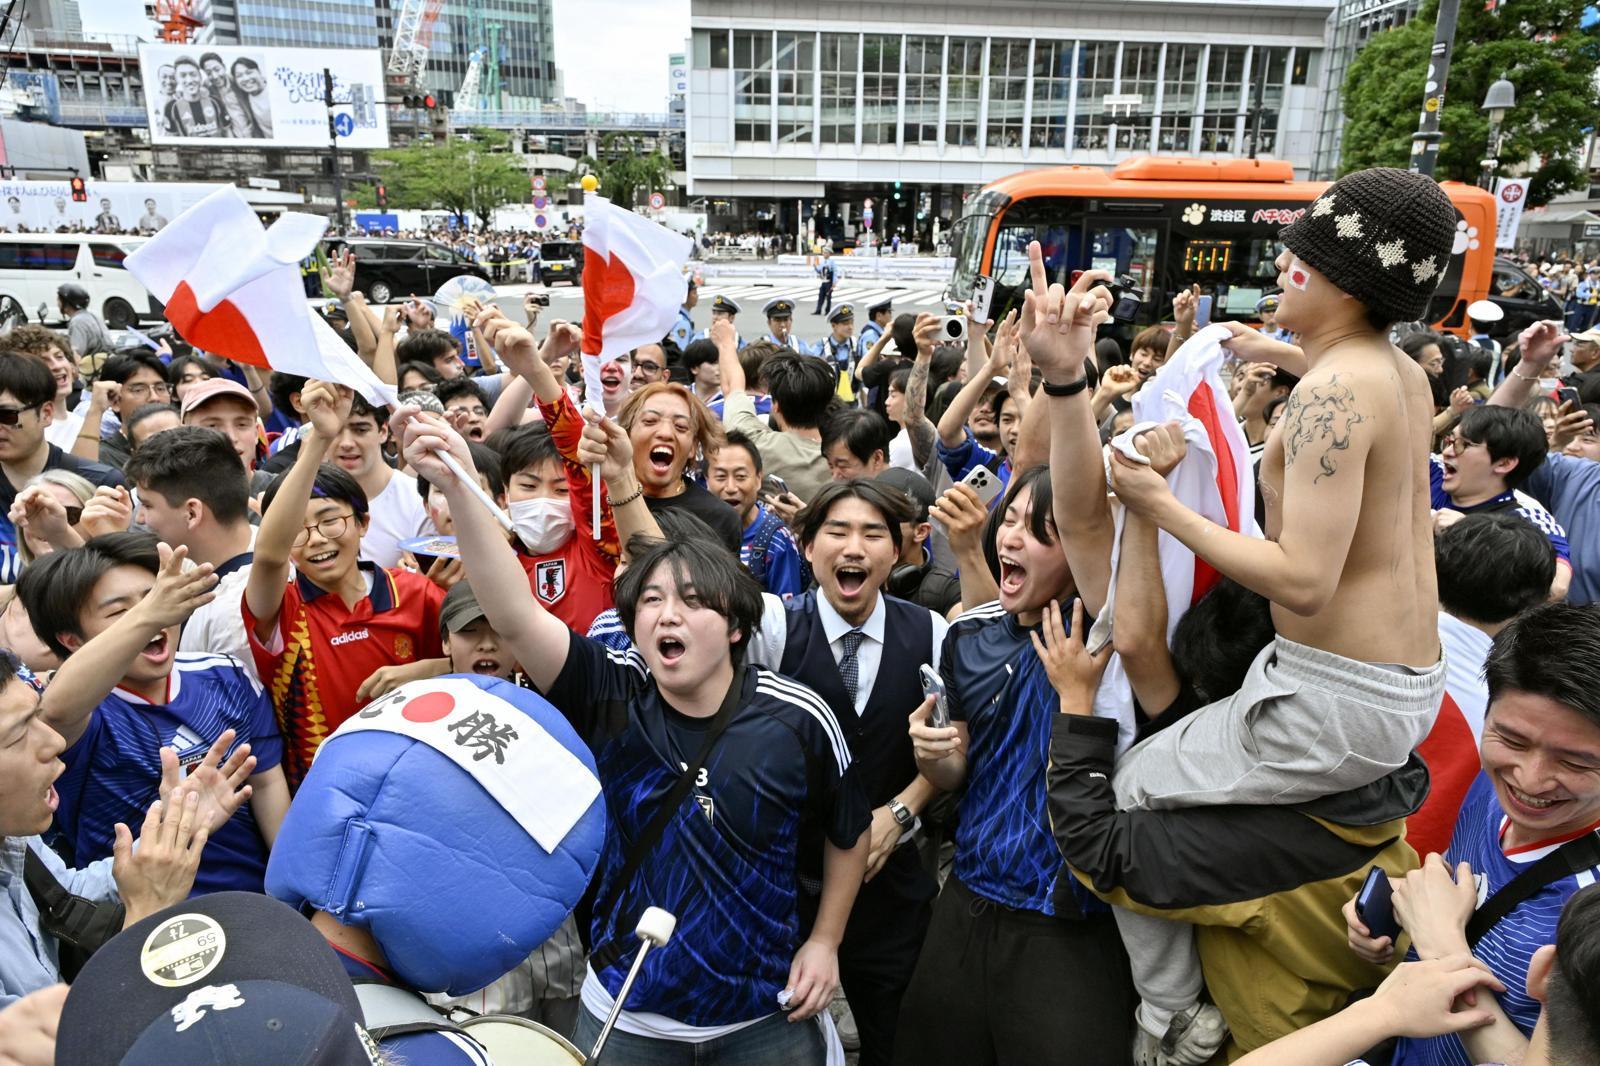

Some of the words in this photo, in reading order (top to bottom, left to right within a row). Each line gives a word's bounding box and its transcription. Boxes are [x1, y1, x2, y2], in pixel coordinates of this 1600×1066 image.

[1210, 209, 1246, 222] 渋谷区
[330, 628, 369, 646] adidas
[447, 709, 519, 765] 勝
[182, 754, 202, 765] JAPAN
[197, 932, 216, 947] 59
